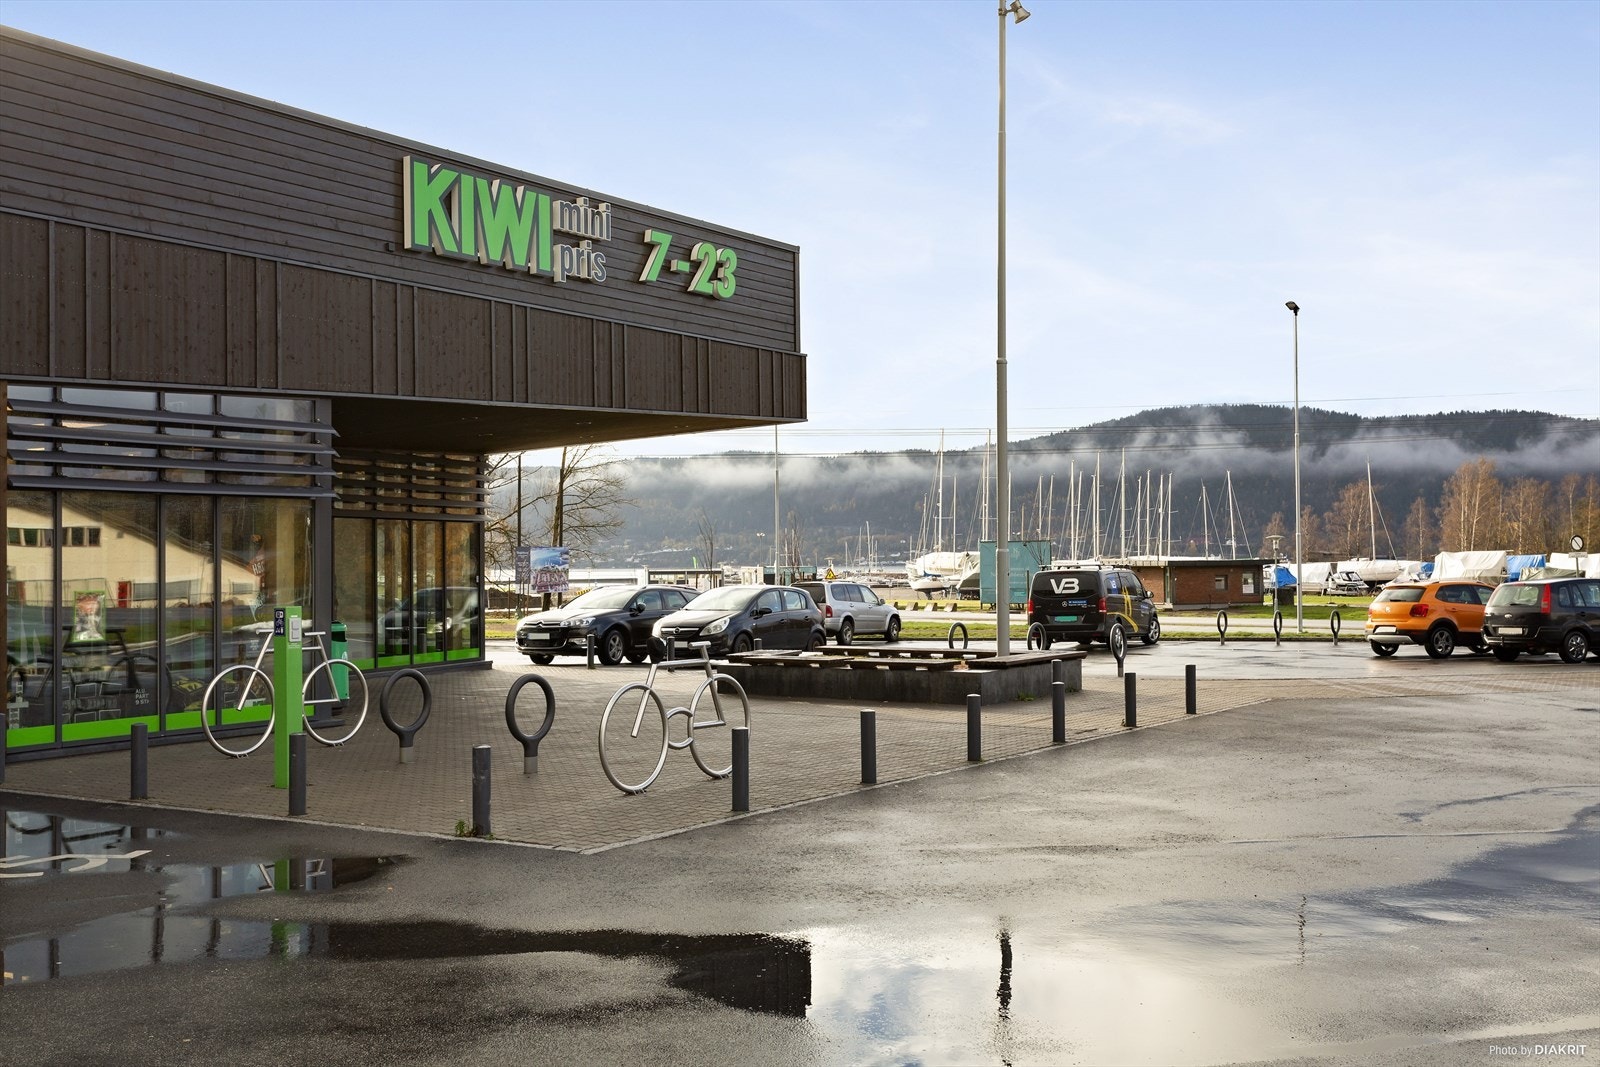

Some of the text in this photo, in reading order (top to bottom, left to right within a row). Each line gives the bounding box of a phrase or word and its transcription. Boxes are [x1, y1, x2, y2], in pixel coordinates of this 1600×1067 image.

[403, 155, 554, 277] KIWI
[553, 197, 612, 241] mini
[553, 240, 607, 283] pris
[639, 229, 738, 300] 7-23
[1050, 577, 1080, 594] VB
